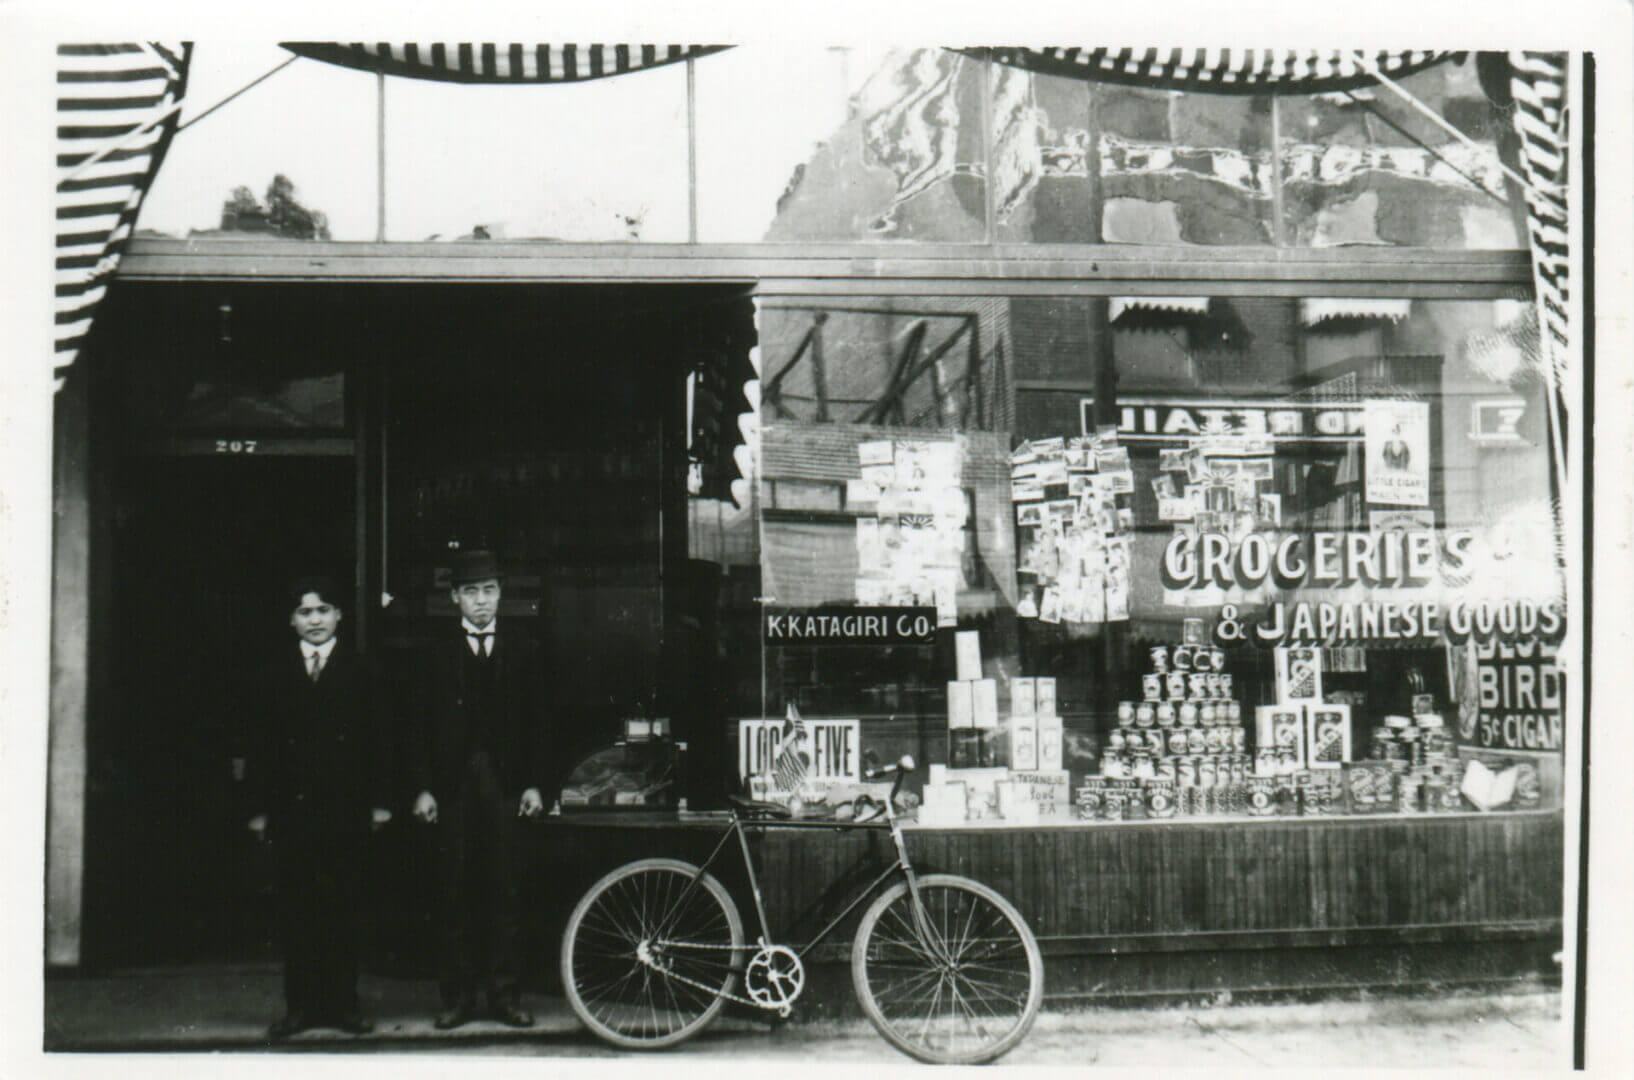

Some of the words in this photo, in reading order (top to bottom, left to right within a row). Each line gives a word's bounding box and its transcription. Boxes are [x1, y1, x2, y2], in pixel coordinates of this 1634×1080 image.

[215, 439, 257, 453] 207
[1163, 531, 1474, 583] GROCERIES
[1217, 604, 1247, 640] &
[1257, 601, 1439, 641] JAPANESE
[1449, 600, 1561, 635] GOODS
[1479, 664, 1560, 709] BIRD
[814, 725, 854, 777] FIVE
